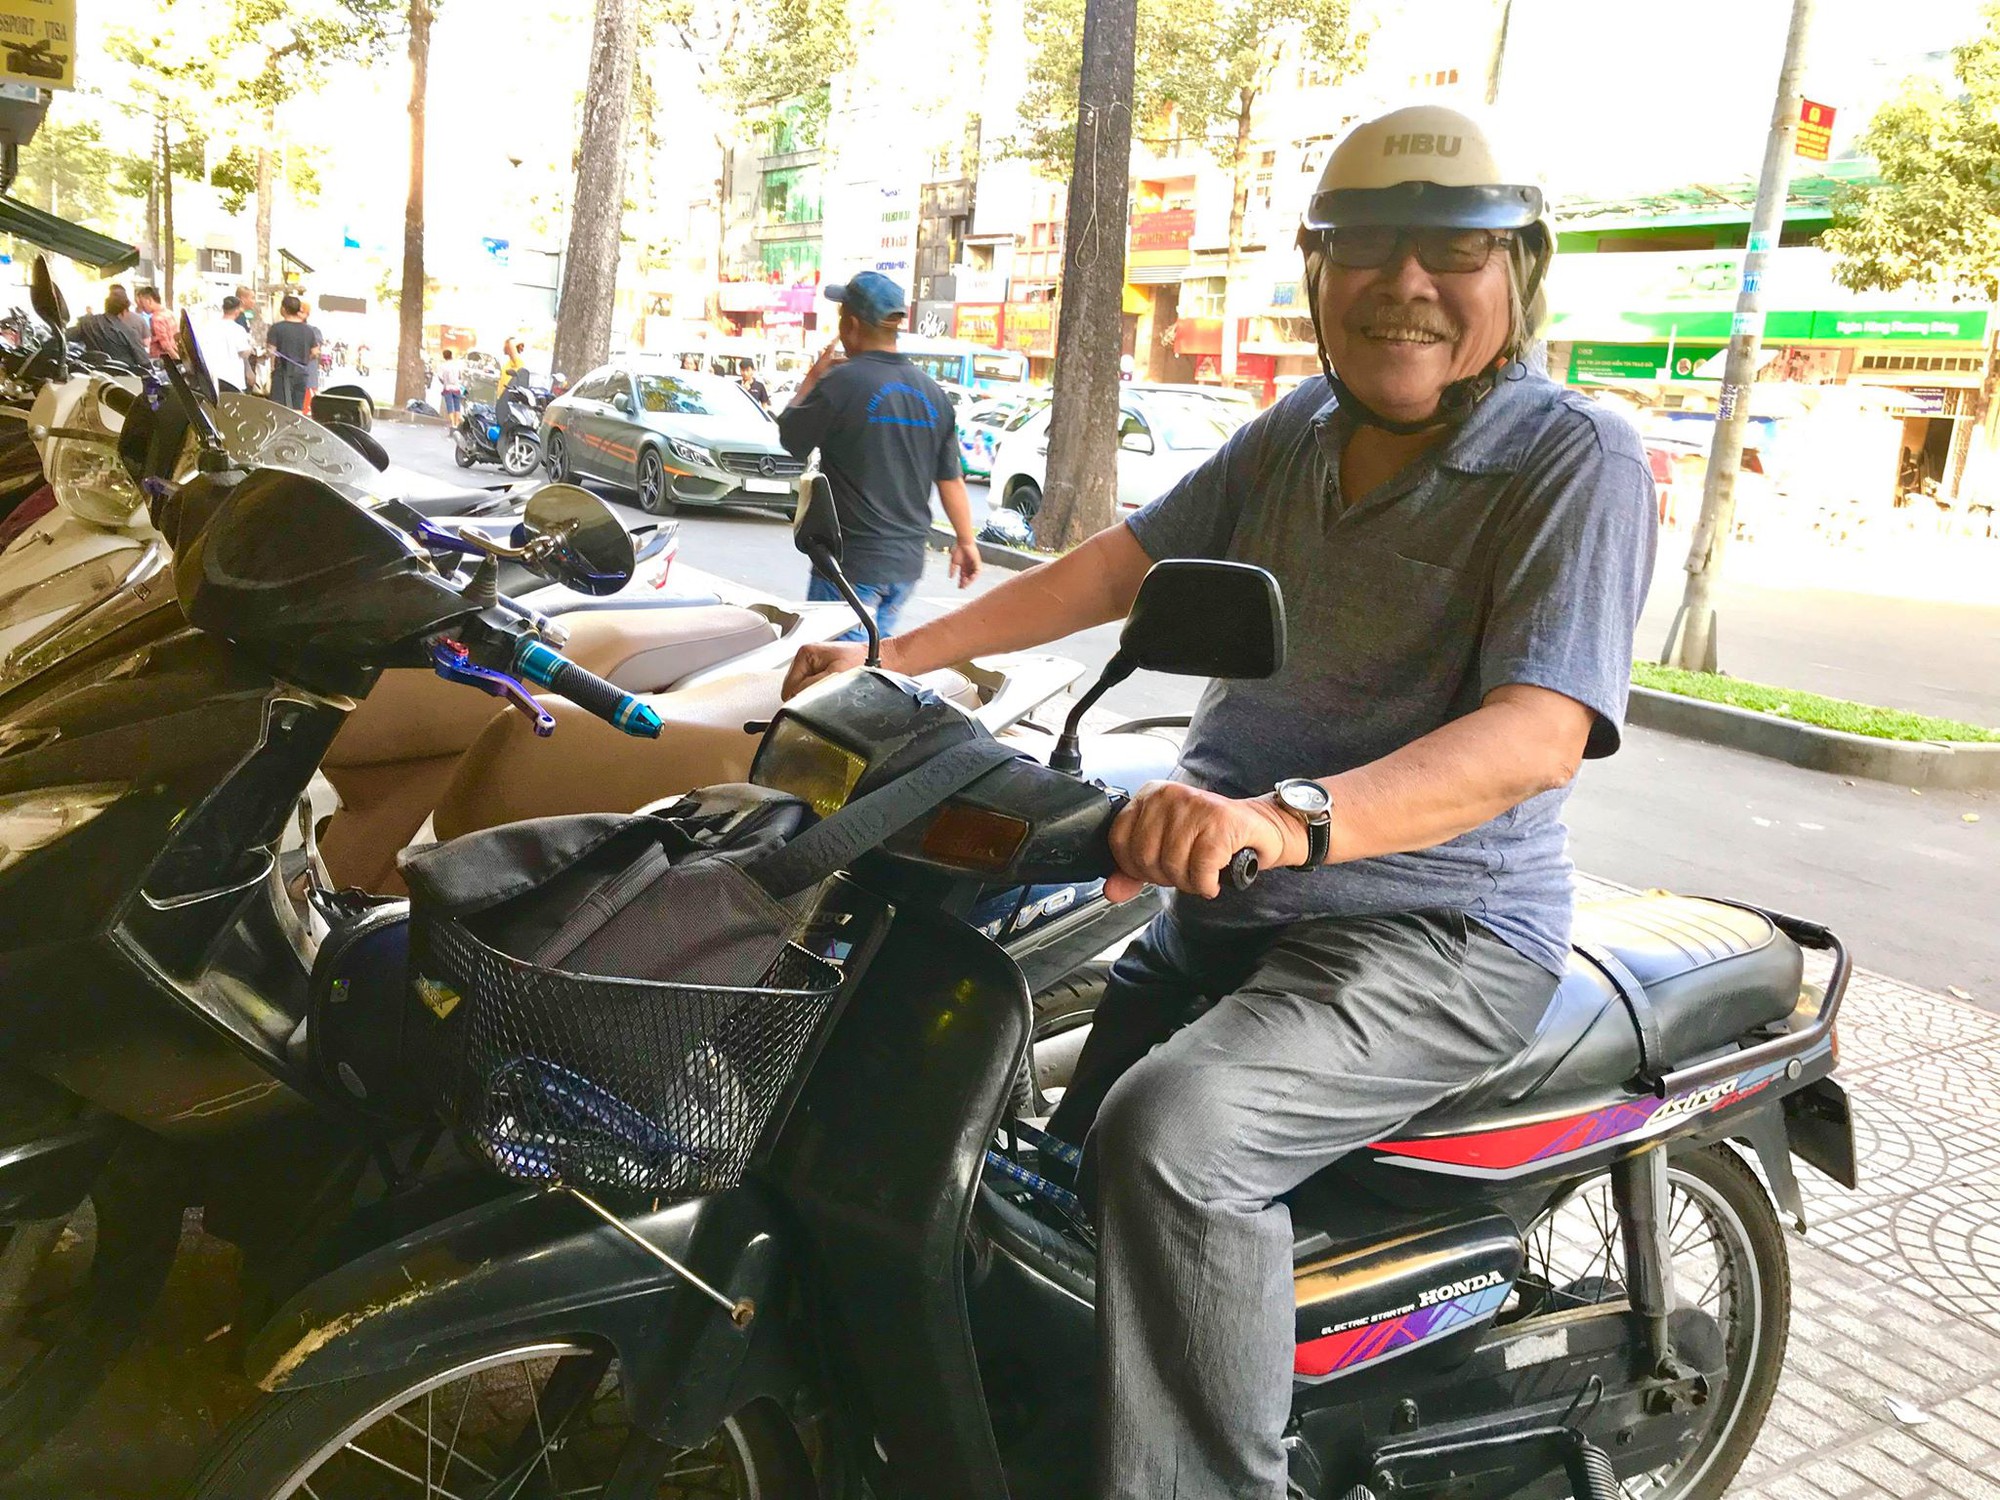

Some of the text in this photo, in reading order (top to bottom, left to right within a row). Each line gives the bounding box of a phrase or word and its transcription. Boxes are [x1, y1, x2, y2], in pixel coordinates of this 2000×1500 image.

[44, 20, 68, 41] VISA
[1383, 133, 1462, 157] HBU
[1321, 1270, 1505, 1336] ELECTRIC STARTER HONDA
